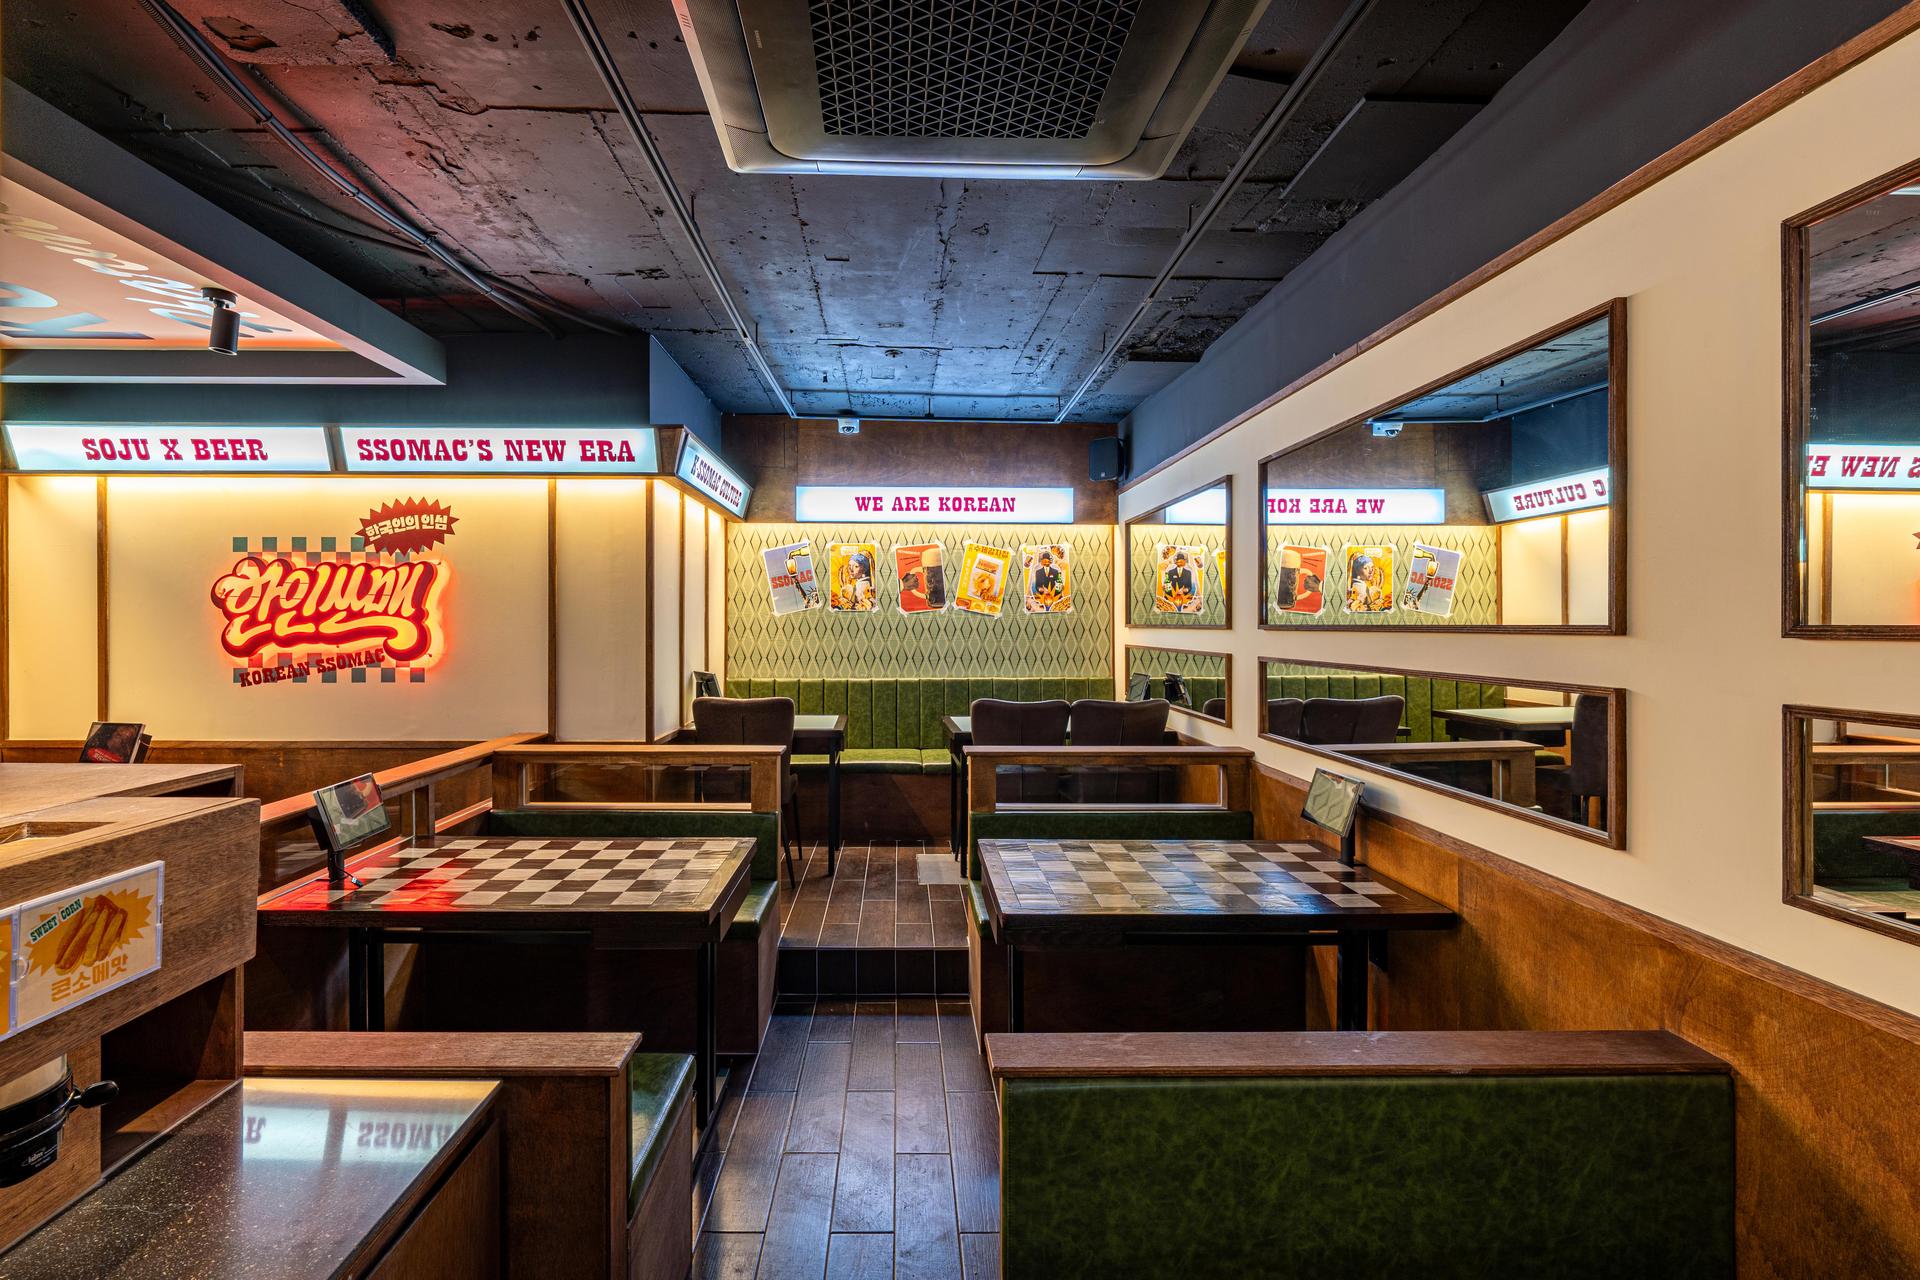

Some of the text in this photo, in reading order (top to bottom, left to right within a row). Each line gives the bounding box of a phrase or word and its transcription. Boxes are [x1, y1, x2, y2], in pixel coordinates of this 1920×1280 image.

[81, 438, 268, 461] SOJU X BEER
[356, 438, 636, 463] SSOMAC'S NEW ERA
[855, 496, 1016, 513] WE ARE KOREAN
[365, 513, 448, 542] 한국인의 인심
[239, 648, 386, 688] KOREAN SSOMAC
[29, 898, 82, 943] SWEET CORN
[51, 953, 129, 1002] 콘소메맛
